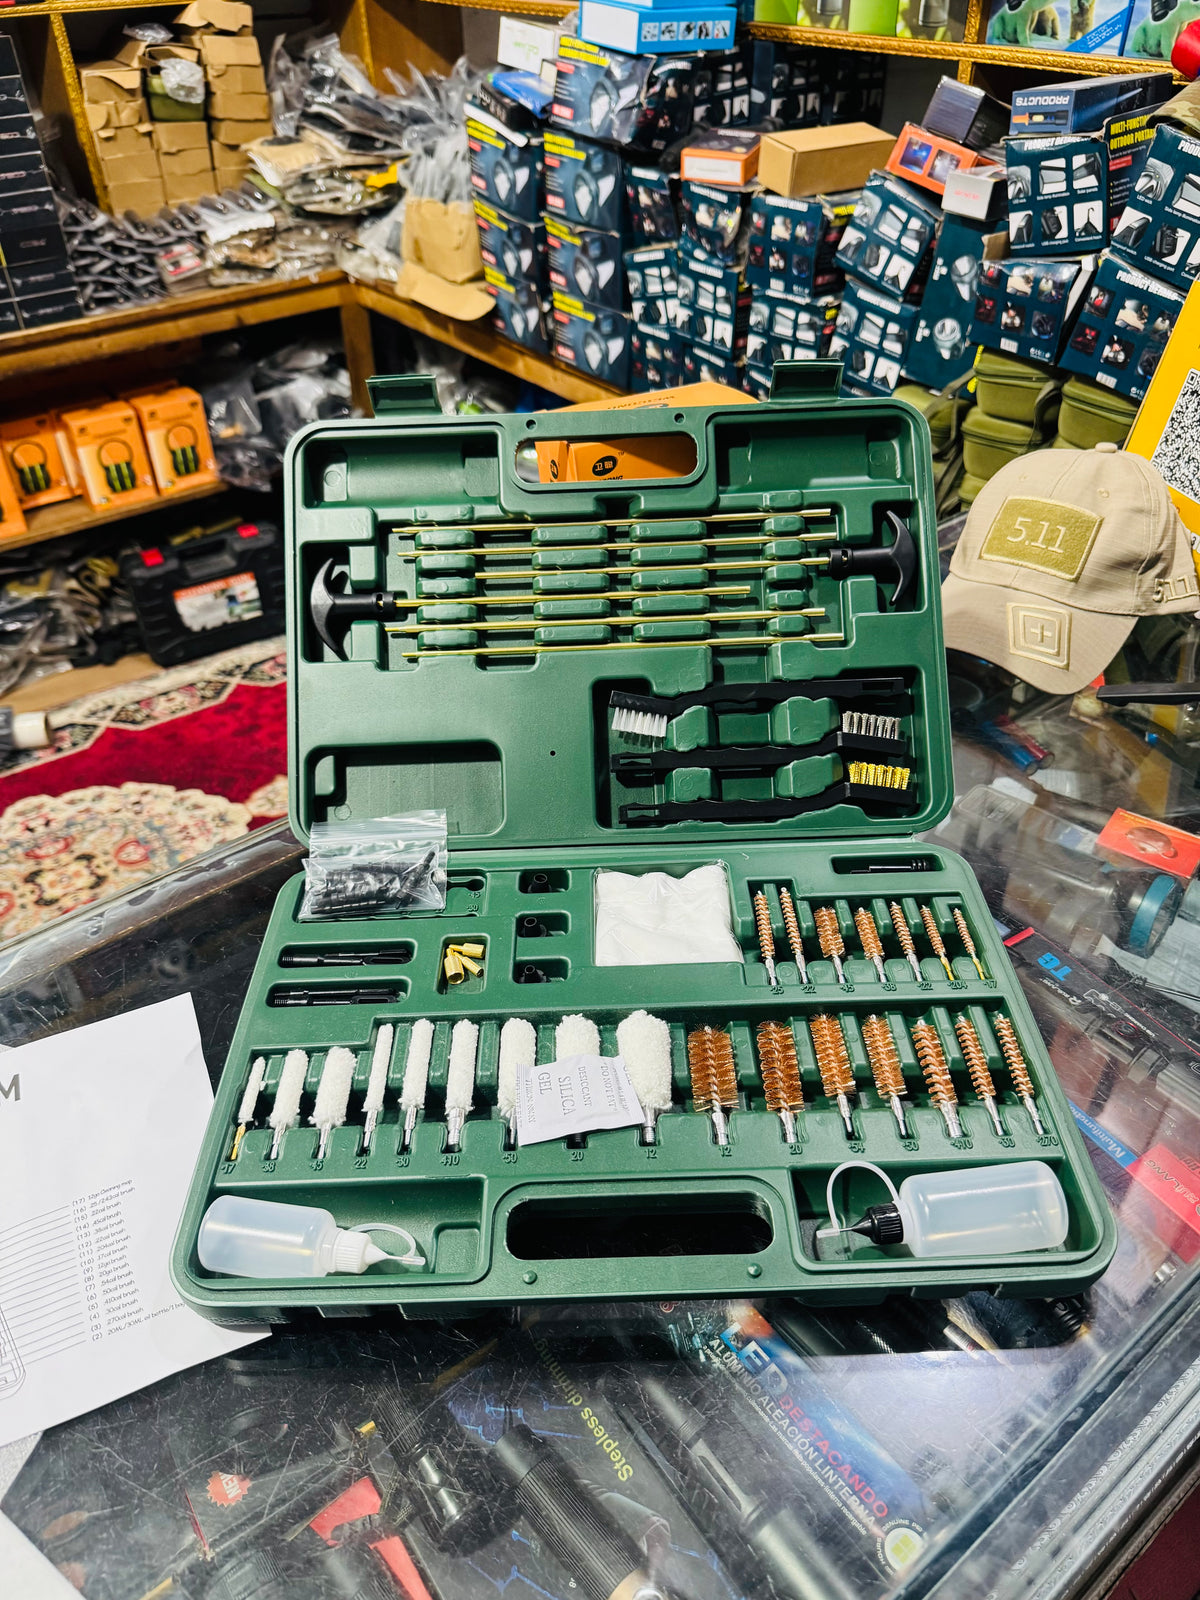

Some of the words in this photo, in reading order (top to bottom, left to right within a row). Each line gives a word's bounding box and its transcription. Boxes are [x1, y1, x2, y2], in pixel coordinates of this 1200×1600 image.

[1016, 94, 1070, 106] PRODUCTS
[1109, 134, 1134, 150] OUTDOOR
[1006, 516, 1068, 554] 5.11
[1036, 952, 1072, 982] TG
[538, 1072, 552, 1095] GEL
[558, 1076, 577, 1116] SILICA
[646, 1148, 657, 1159] 12
[720, 1146, 732, 1157] 12
[789, 1144, 803, 1155] 20
[571, 1151, 584, 1162] 20
[83, 1266, 93, 1275] (9)
[84, 1274, 94, 1283] (8)
[85, 1283, 96, 1292] (7)
[87, 1293, 97, 1302] (6)
[88, 1302, 98, 1311] (5)
[90, 1312, 100, 1322] (4)
[91, 1323, 101, 1332] (3)
[92, 1332, 103, 1342] (2)
[534, 1338, 582, 1407] dimming
[720, 1322, 788, 1394] LED
[777, 1392, 890, 1520] DESTACANDO
[757, 1392, 818, 1460] ALEACIÓN
[580, 1406, 634, 1482] Stepless
